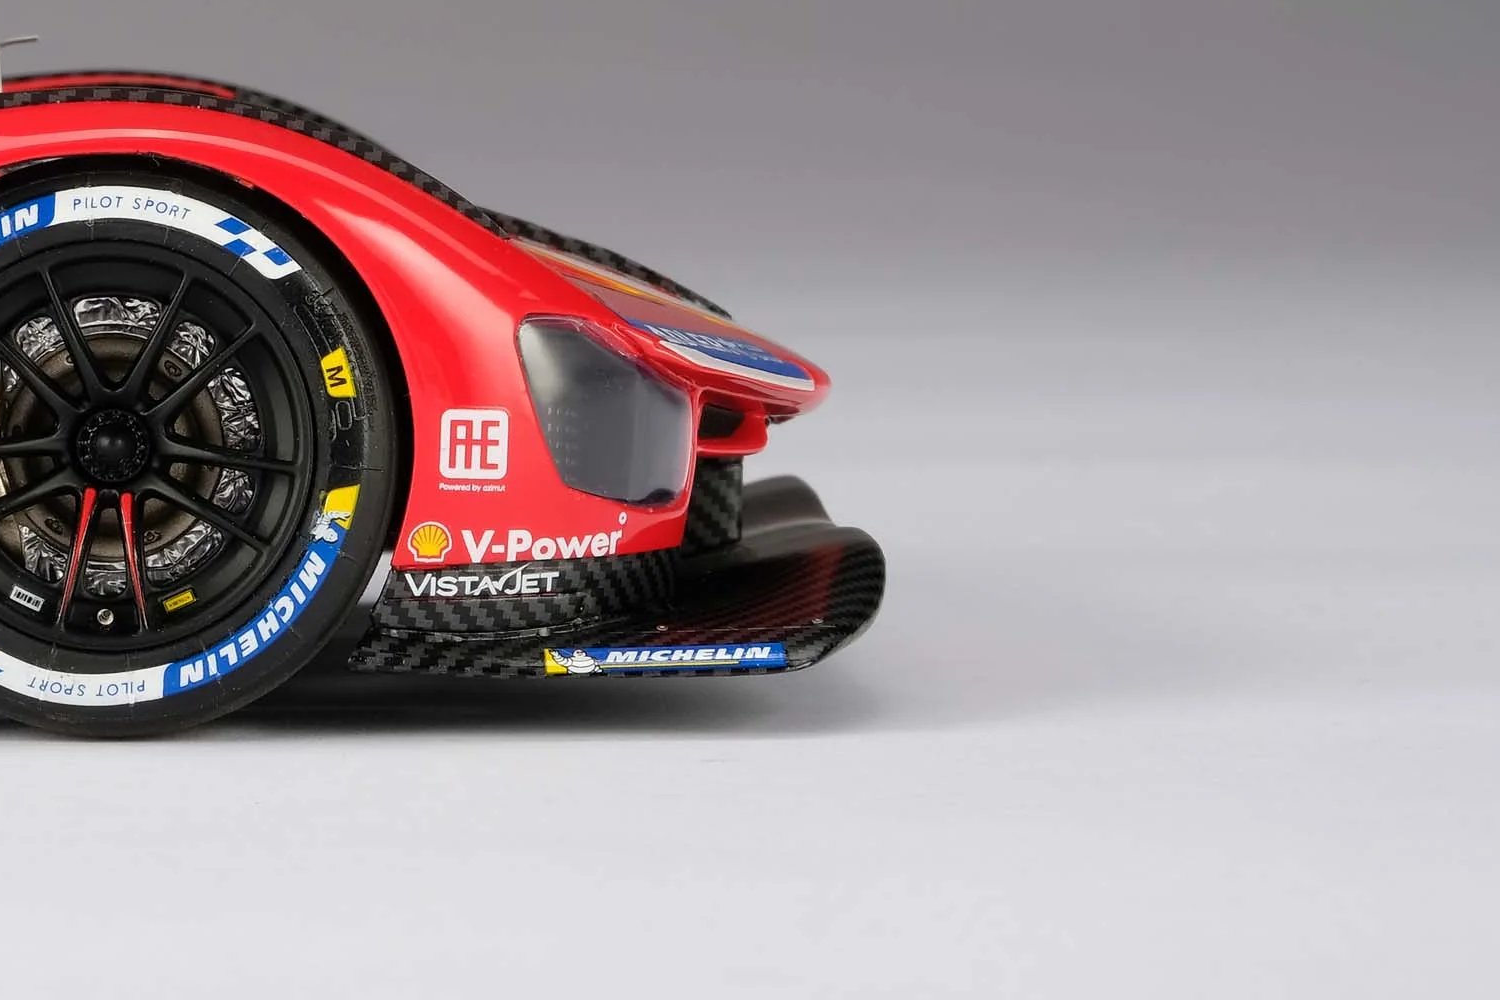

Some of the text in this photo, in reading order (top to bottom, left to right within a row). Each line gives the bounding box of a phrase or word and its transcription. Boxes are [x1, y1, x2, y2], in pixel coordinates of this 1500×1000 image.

[73, 196, 191, 220] PILOT SPORT
[325, 364, 347, 388] M
[439, 482, 471, 492] Powered
[472, 483, 482, 493] by
[461, 529, 623, 564] V-Power
[180, 551, 326, 688] MICHELIN
[605, 646, 772, 663] MICHELIN
[27, 676, 146, 697] PILOT SPORT
